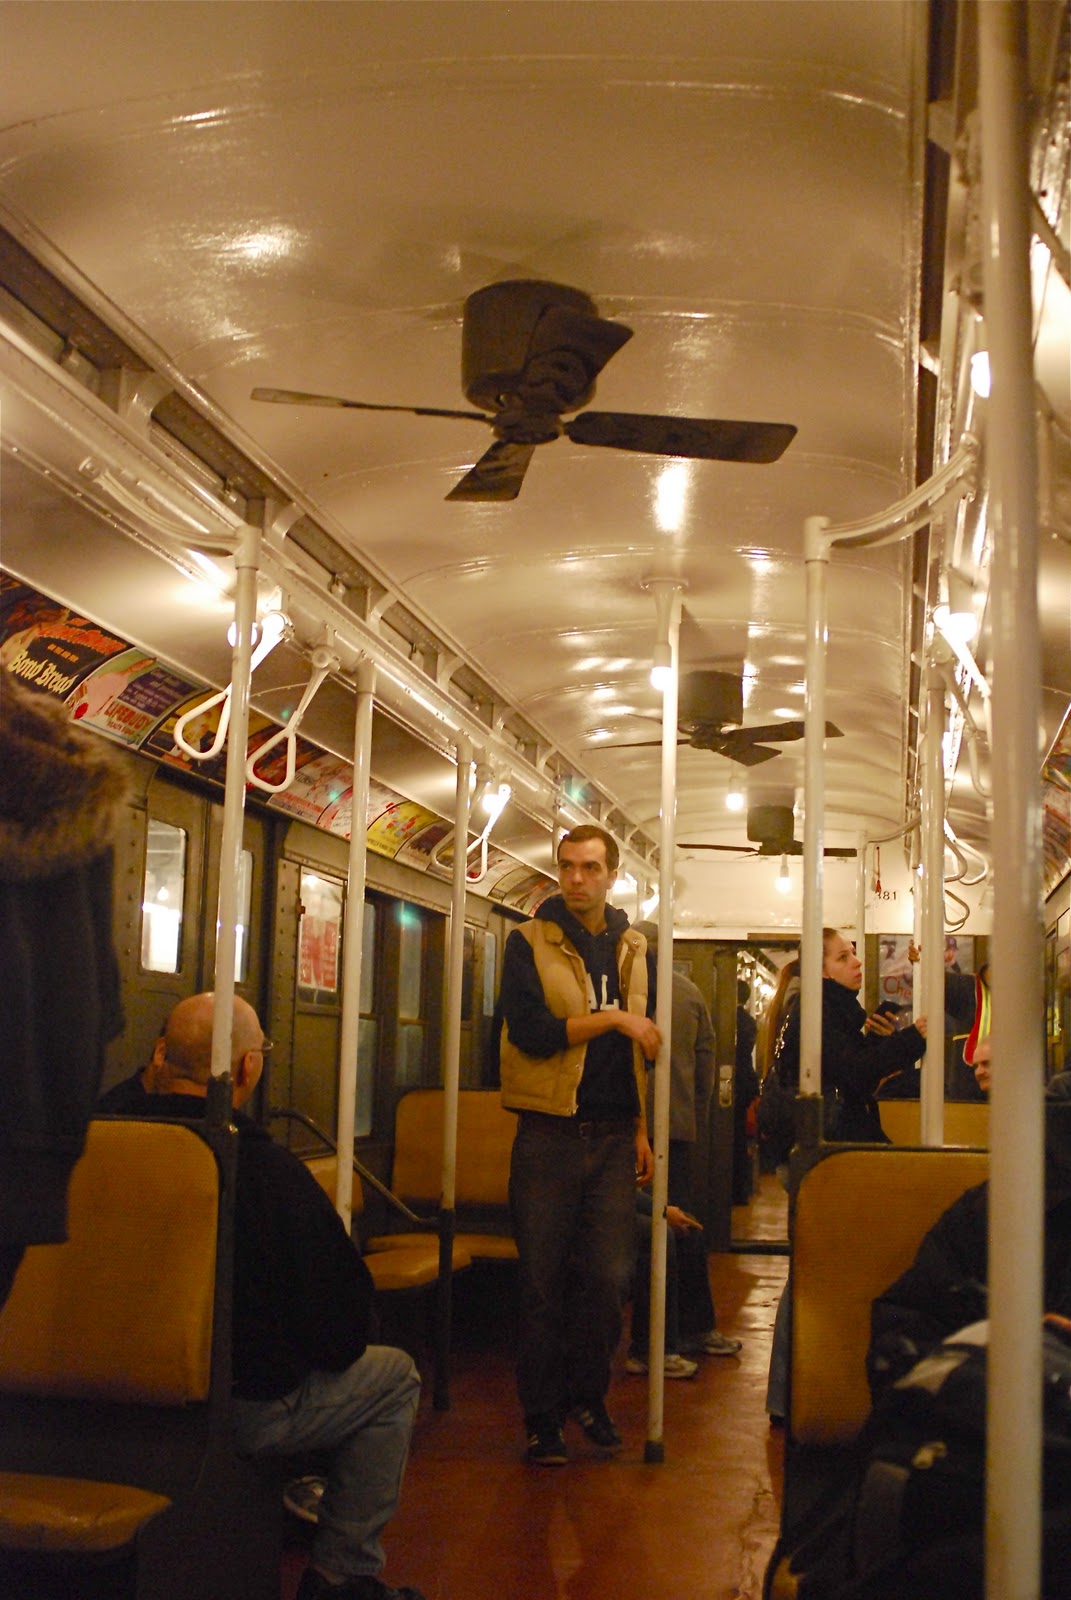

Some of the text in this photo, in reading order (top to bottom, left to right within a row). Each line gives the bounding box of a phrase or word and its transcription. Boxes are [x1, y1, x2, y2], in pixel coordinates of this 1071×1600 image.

[8, 650, 79, 694] Bond Bread
[104, 702, 154, 731] LIFEBUOY
